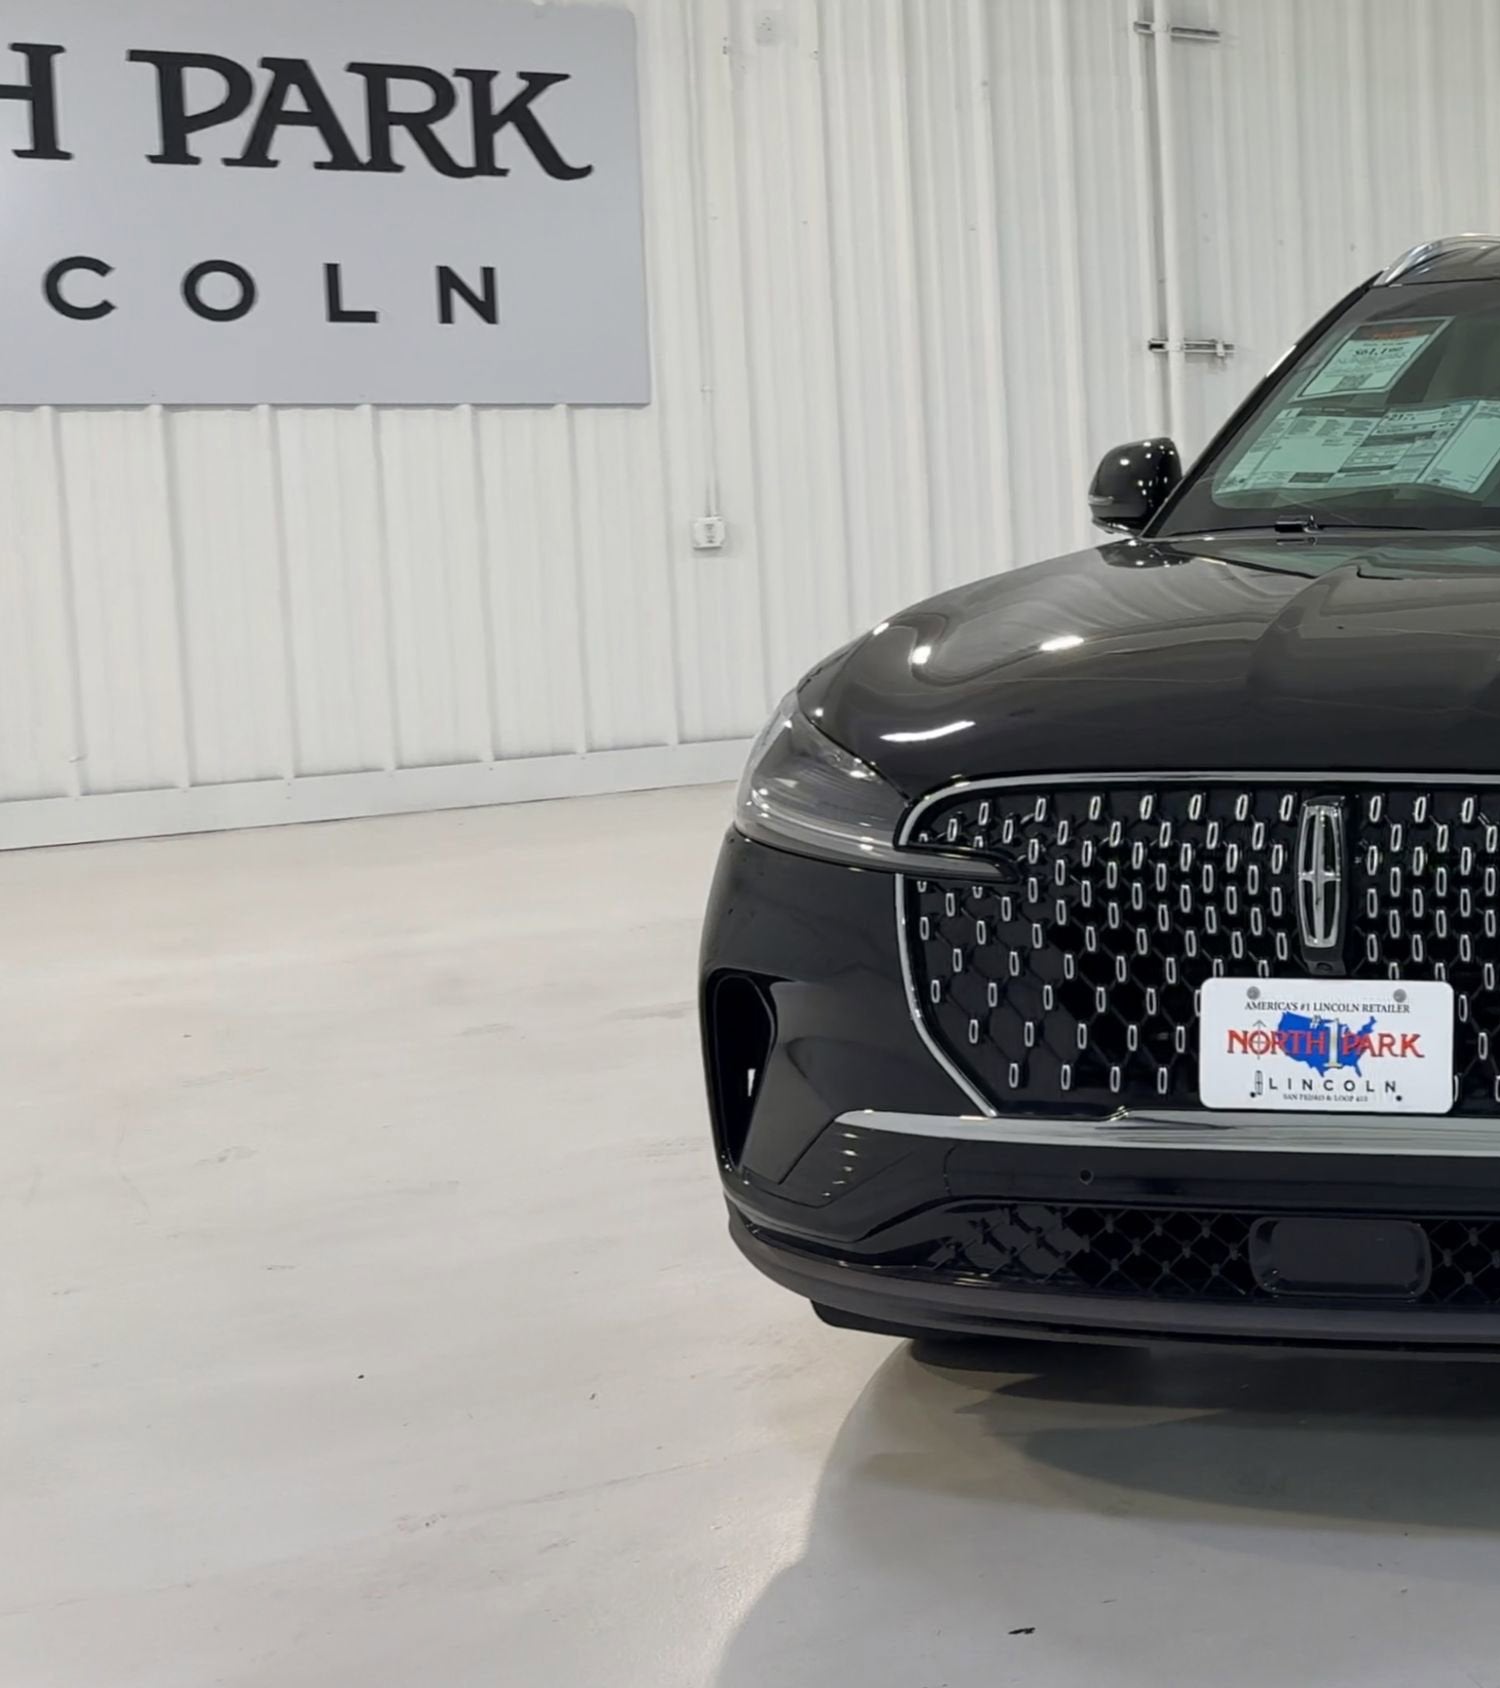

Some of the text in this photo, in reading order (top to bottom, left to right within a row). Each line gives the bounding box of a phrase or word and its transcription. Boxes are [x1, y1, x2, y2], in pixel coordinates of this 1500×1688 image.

[126, 49, 593, 181] PARK
[42, 256, 500, 324] COLN
[1245, 1001, 1410, 1013] AMERICA'S #1 LINCOLN RETAILER
[1227, 1029, 1425, 1058] NORTH PARK
[1269, 1077, 1397, 1093] LINCOLN
